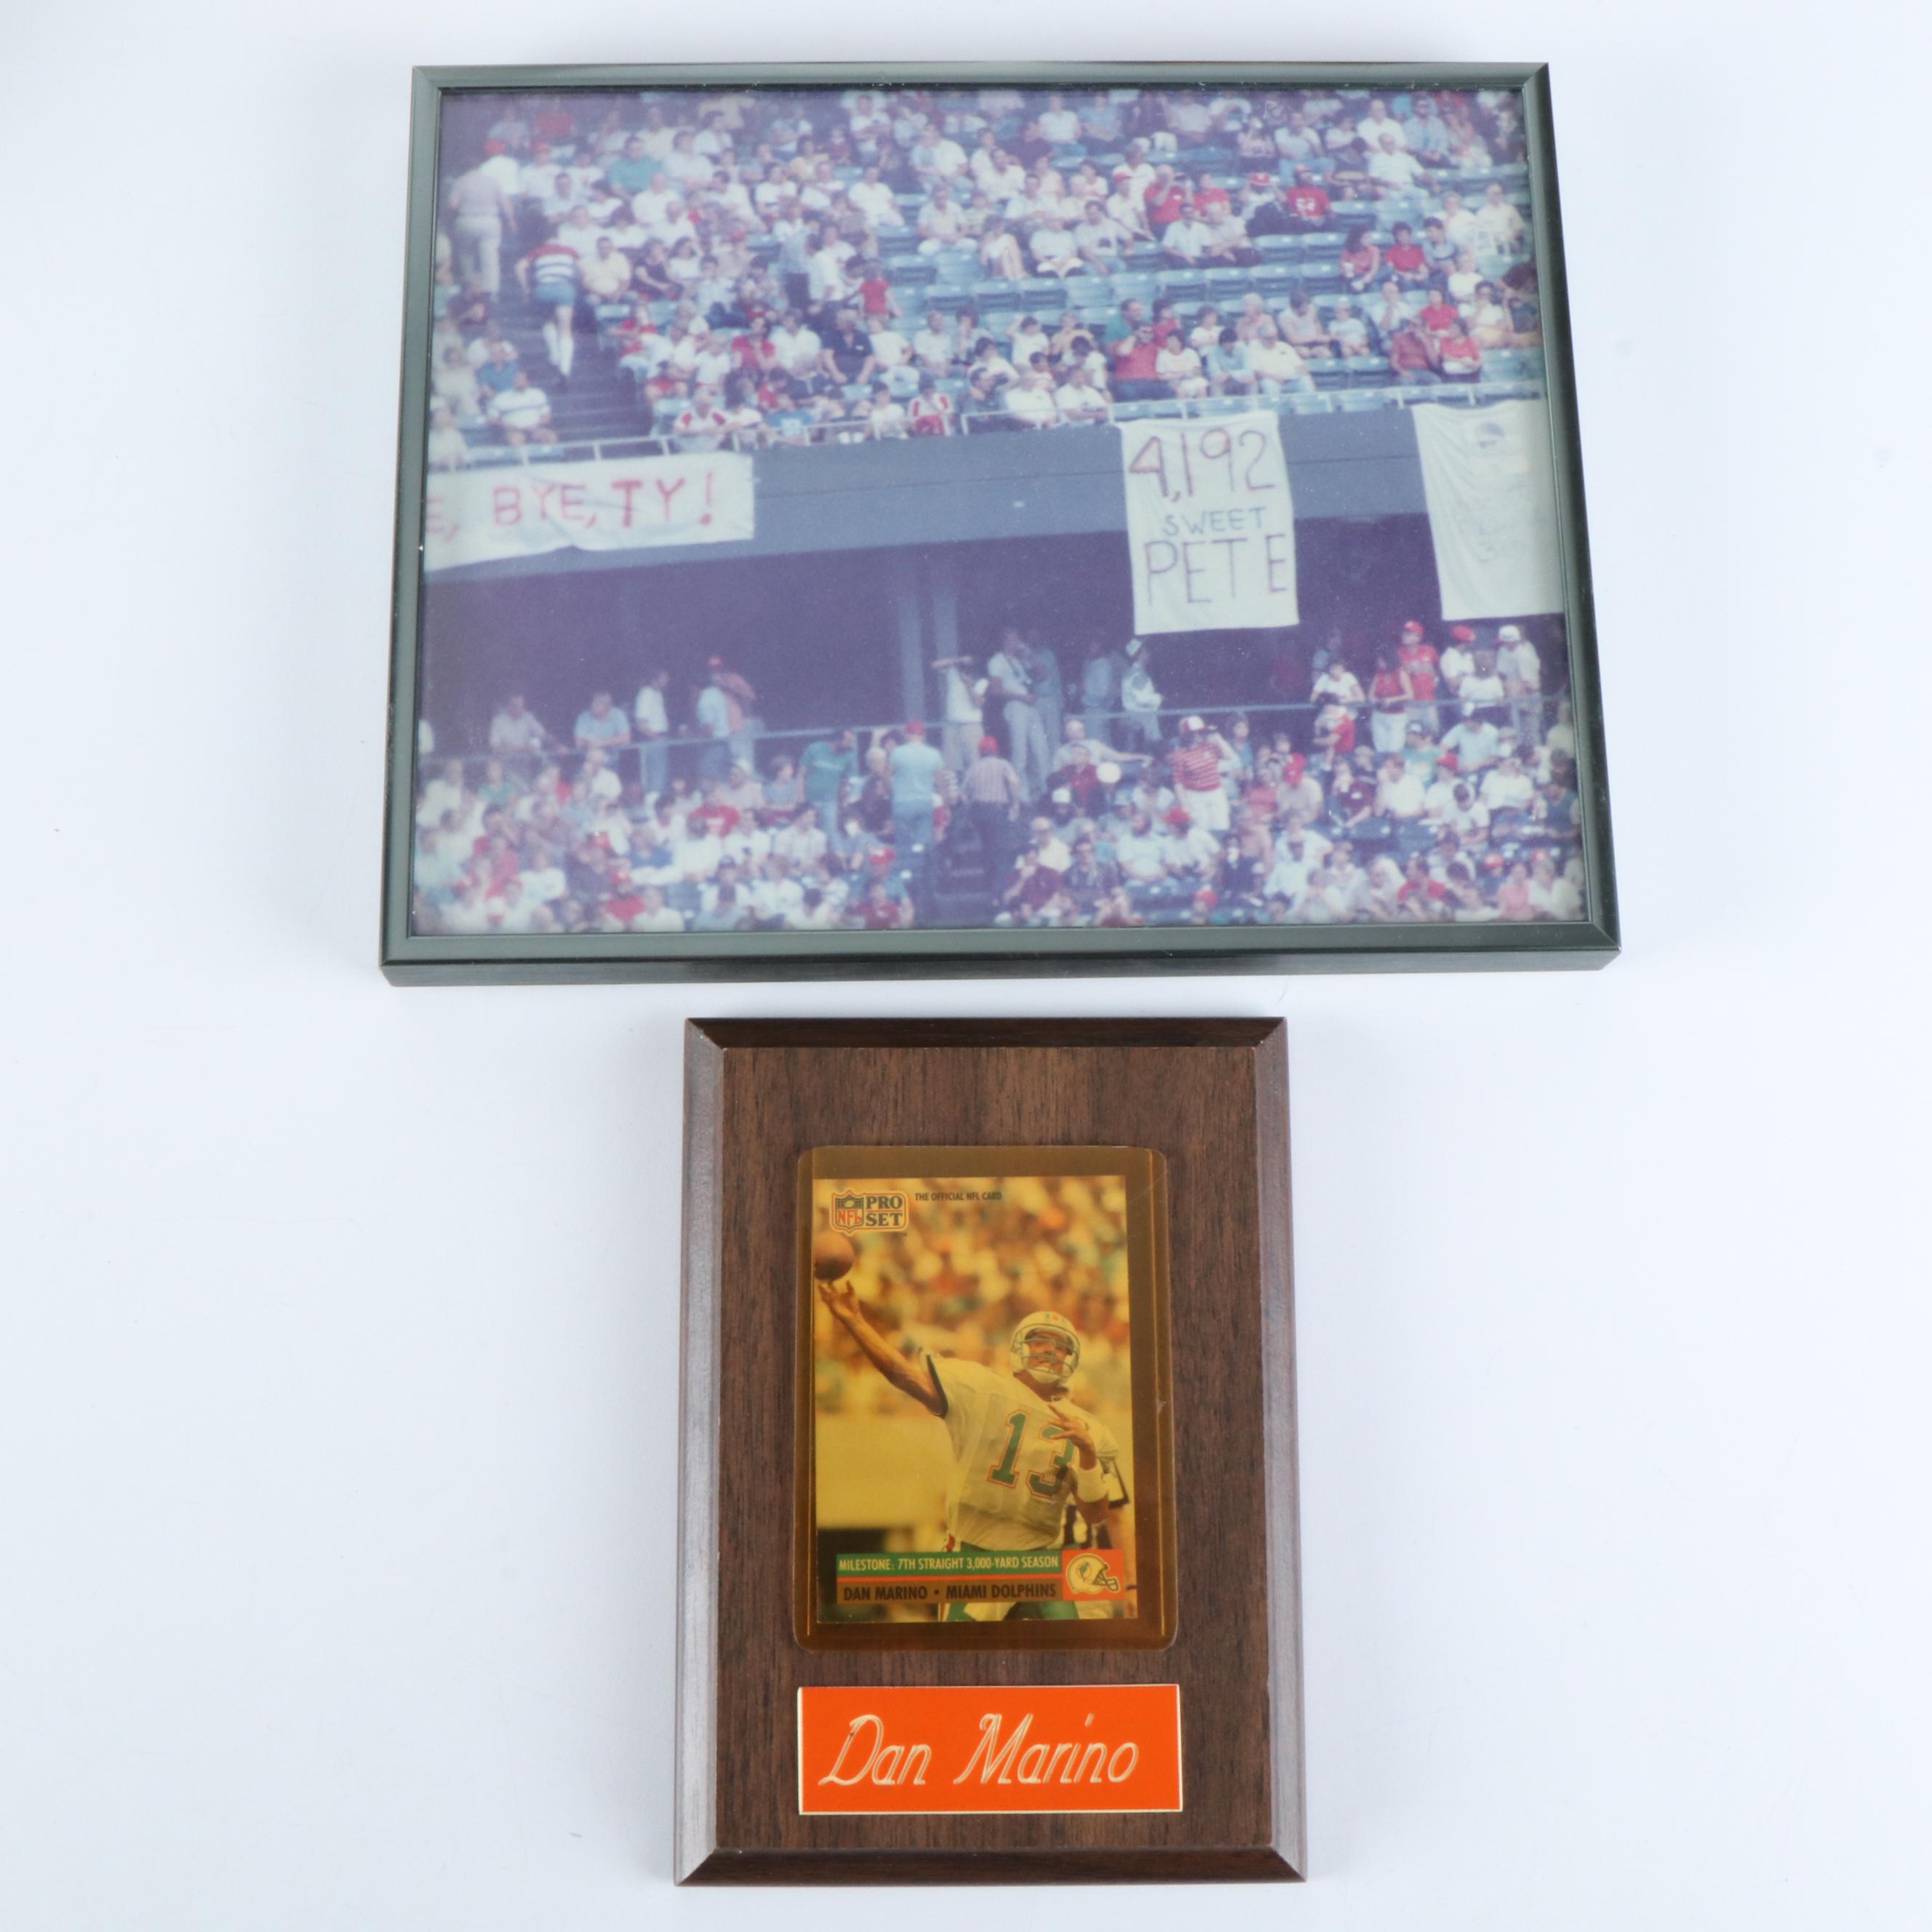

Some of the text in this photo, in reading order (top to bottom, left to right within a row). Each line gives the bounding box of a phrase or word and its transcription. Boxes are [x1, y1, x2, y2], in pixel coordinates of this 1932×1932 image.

[1129, 428, 1276, 502] 4,192
[492, 483, 598, 530] BYE,
[1162, 506, 1267, 536] SWEET
[1144, 533, 1288, 605] PETE
[866, 1195, 903, 1210] PRO
[914, 1191, 1002, 1200] THE OFFICIAL NFL CARD
[837, 1208, 863, 1226] NFL
[866, 1213, 903, 1227] SET
[987, 1408, 1077, 1501] 13
[839, 1558, 895, 1571] MILESTONE:
[898, 1558, 916, 1570] 7TH
[918, 1557, 964, 1570] STRAIGHT
[1021, 1555, 1058, 1568] SEASON
[844, 1583, 1055, 1600] DAN MARINO MIAMI DOLPHINS
[818, 1712, 1138, 1786] Dan Marino
